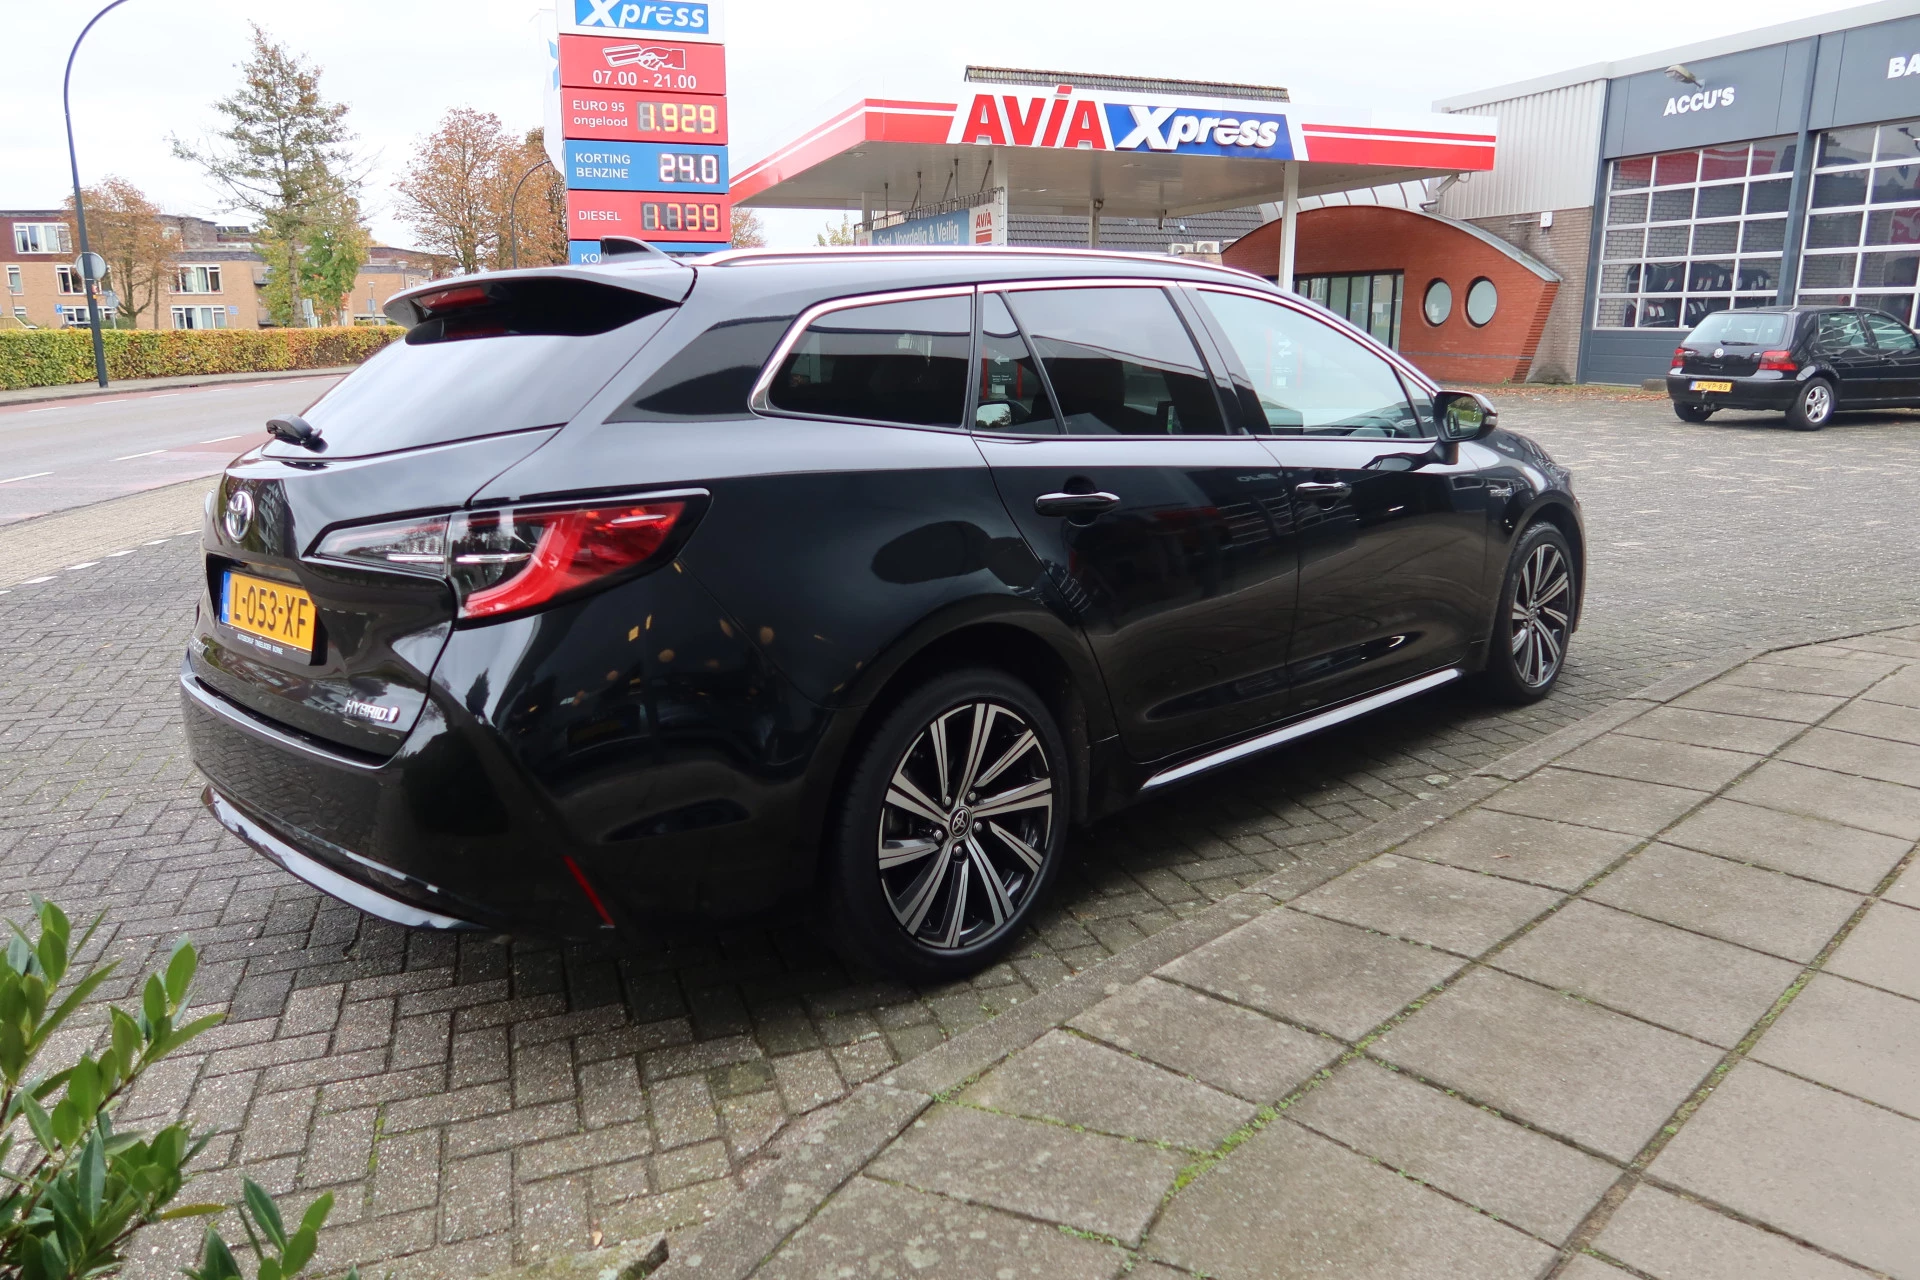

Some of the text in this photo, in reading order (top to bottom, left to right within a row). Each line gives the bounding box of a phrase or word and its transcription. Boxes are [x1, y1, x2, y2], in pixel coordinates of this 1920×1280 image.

[579, 0, 705, 28] Xpress
[592, 69, 638, 86] 07.00
[653, 73, 697, 89] 21.00
[572, 99, 625, 112] EURO 95
[1663, 86, 1735, 117] ACCU'S
[573, 115, 628, 127] ongelood
[650, 103, 716, 133] 1.929
[1115, 105, 1279, 151] Xpress
[575, 152, 631, 165] KORTING
[660, 153, 717, 184] 24.0
[576, 167, 629, 179] BENZINE
[578, 210, 622, 222] DIESEL
[654, 203, 718, 231] 1.739
[928, 225, 935, 244] &
[936, 220, 959, 244] Veilig
[234, 581, 308, 639] L-053-XF
[344, 699, 389, 721] HYBRID
